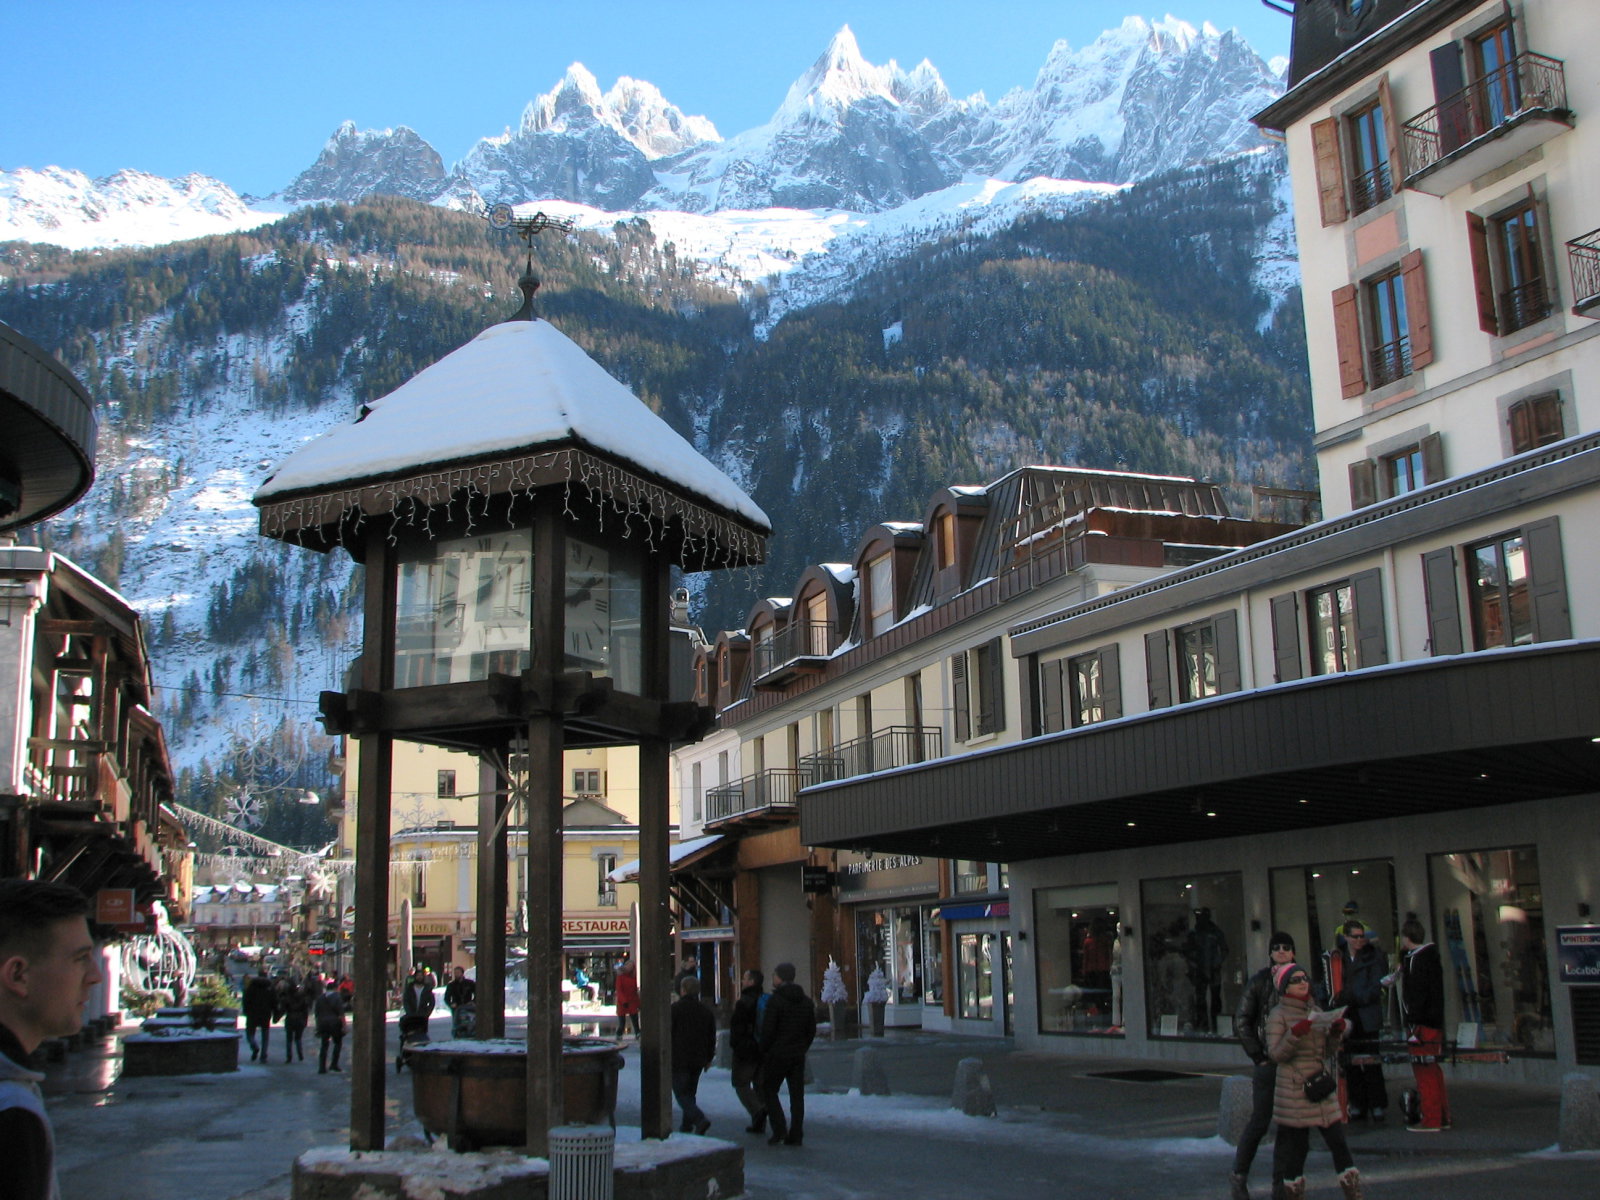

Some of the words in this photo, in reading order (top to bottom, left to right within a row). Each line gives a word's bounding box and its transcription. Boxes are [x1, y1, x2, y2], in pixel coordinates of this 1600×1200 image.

[848, 858, 882, 875] PARFUMERIE
[885, 856, 897, 870] DES
[900, 855, 919, 868] ALPES
[562, 920, 630, 933] RESTAURA
